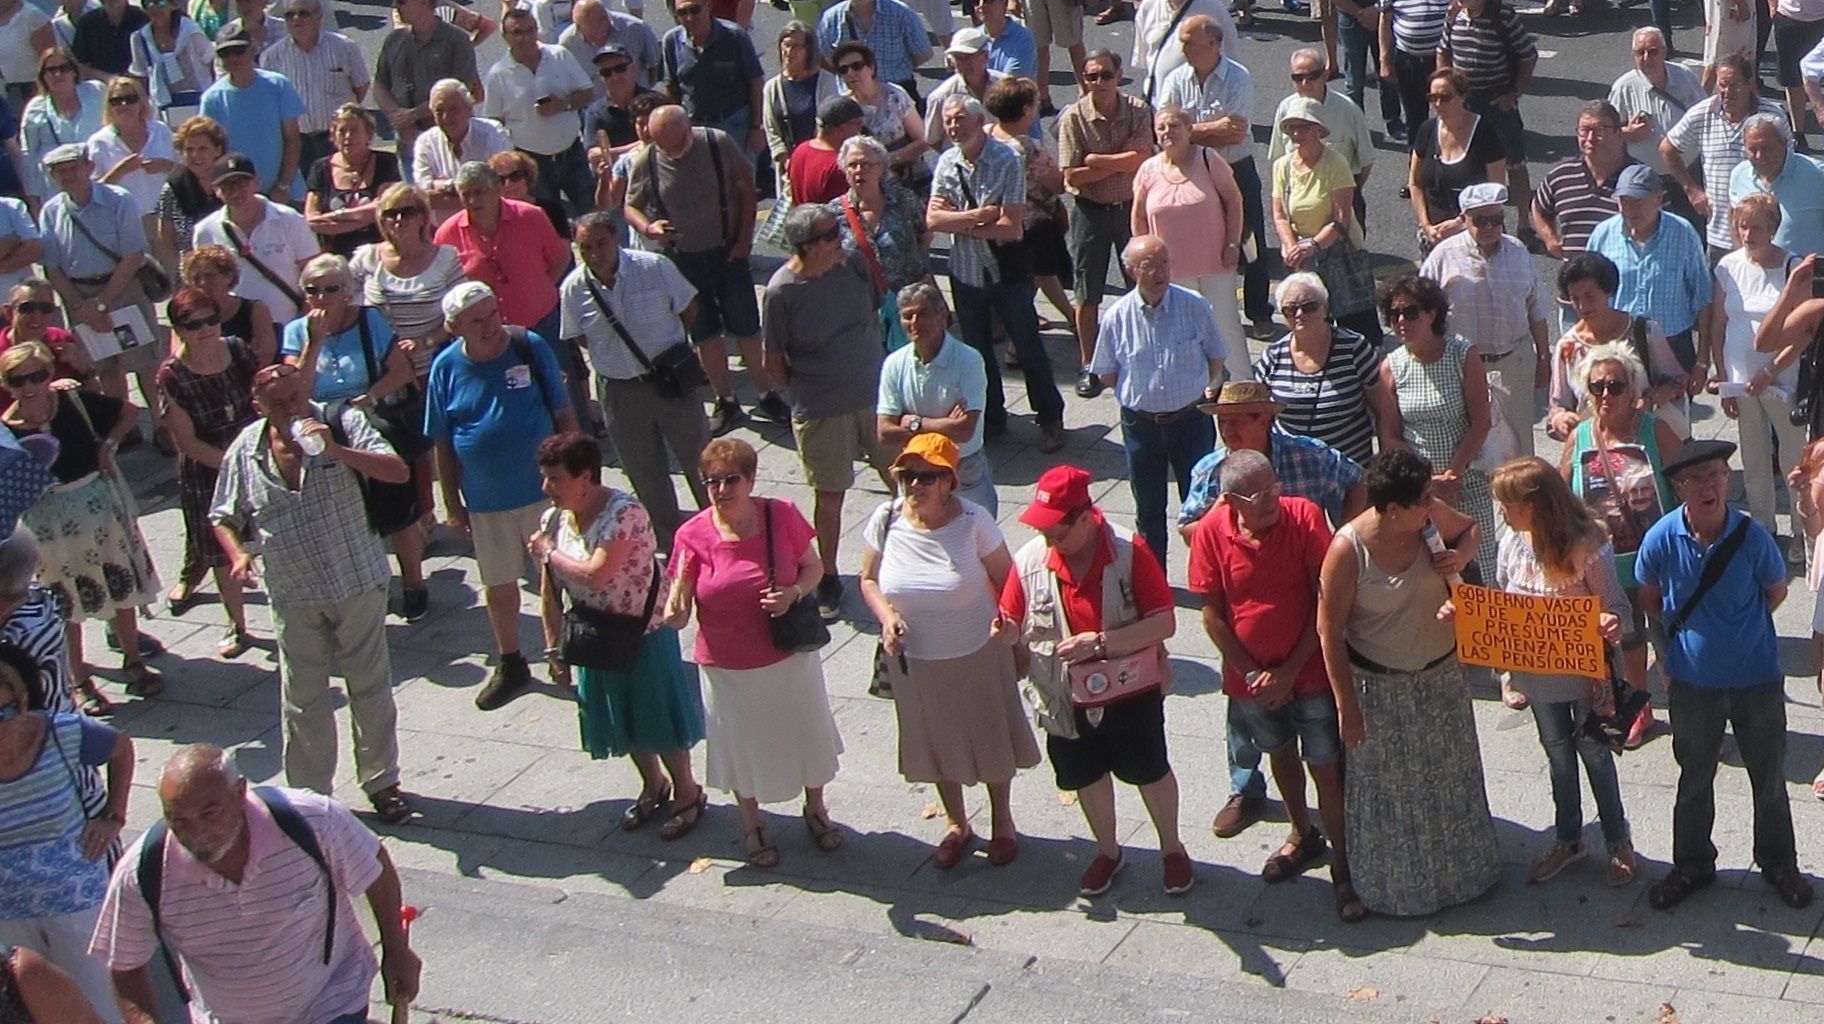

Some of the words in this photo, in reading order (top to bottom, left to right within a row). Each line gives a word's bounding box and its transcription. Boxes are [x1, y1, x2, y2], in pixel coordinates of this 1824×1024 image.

[1456, 584, 1534, 610] GOBIERNO
[1542, 598, 1593, 613] VASCO
[1465, 602, 1481, 617] SI
[1489, 607, 1508, 622] DE
[1525, 612, 1588, 628] AYUDAS
[1485, 619, 1583, 642] PRESUMES
[1472, 631, 1559, 656] COMIENZA
[1565, 643, 1597, 658] POR
[1462, 645, 1490, 661] LAS
[1502, 651, 1598, 673] PENSIONES
